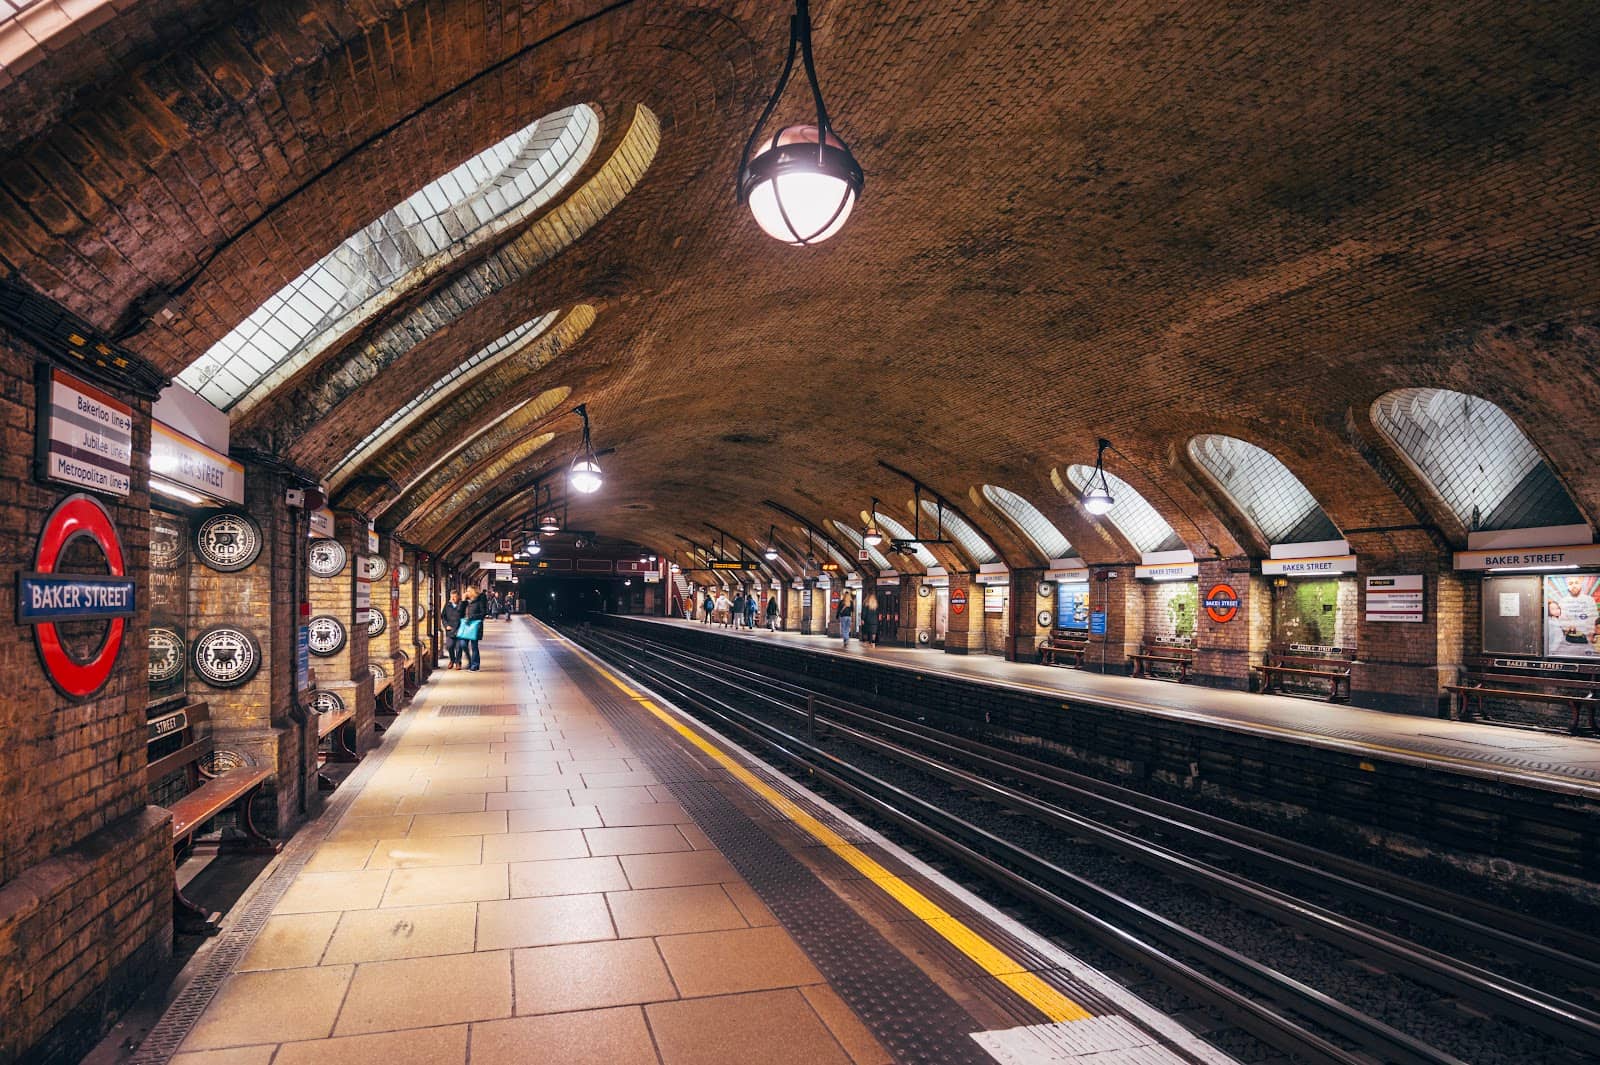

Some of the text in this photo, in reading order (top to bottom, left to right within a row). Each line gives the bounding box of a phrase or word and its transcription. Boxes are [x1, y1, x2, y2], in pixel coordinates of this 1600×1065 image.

[77, 395, 125, 429] Bakerloo line
[82, 432, 109, 453] Jubilee
[58, 458, 122, 489] Metropolitan line
[197, 460, 224, 489] STREET
[1282, 563, 1305, 572] BAKER
[1486, 554, 1564, 565] BAKER STREET
[32, 584, 81, 609] BAKER
[84, 586, 128, 607] STREET
[155, 717, 177, 734] STREET
